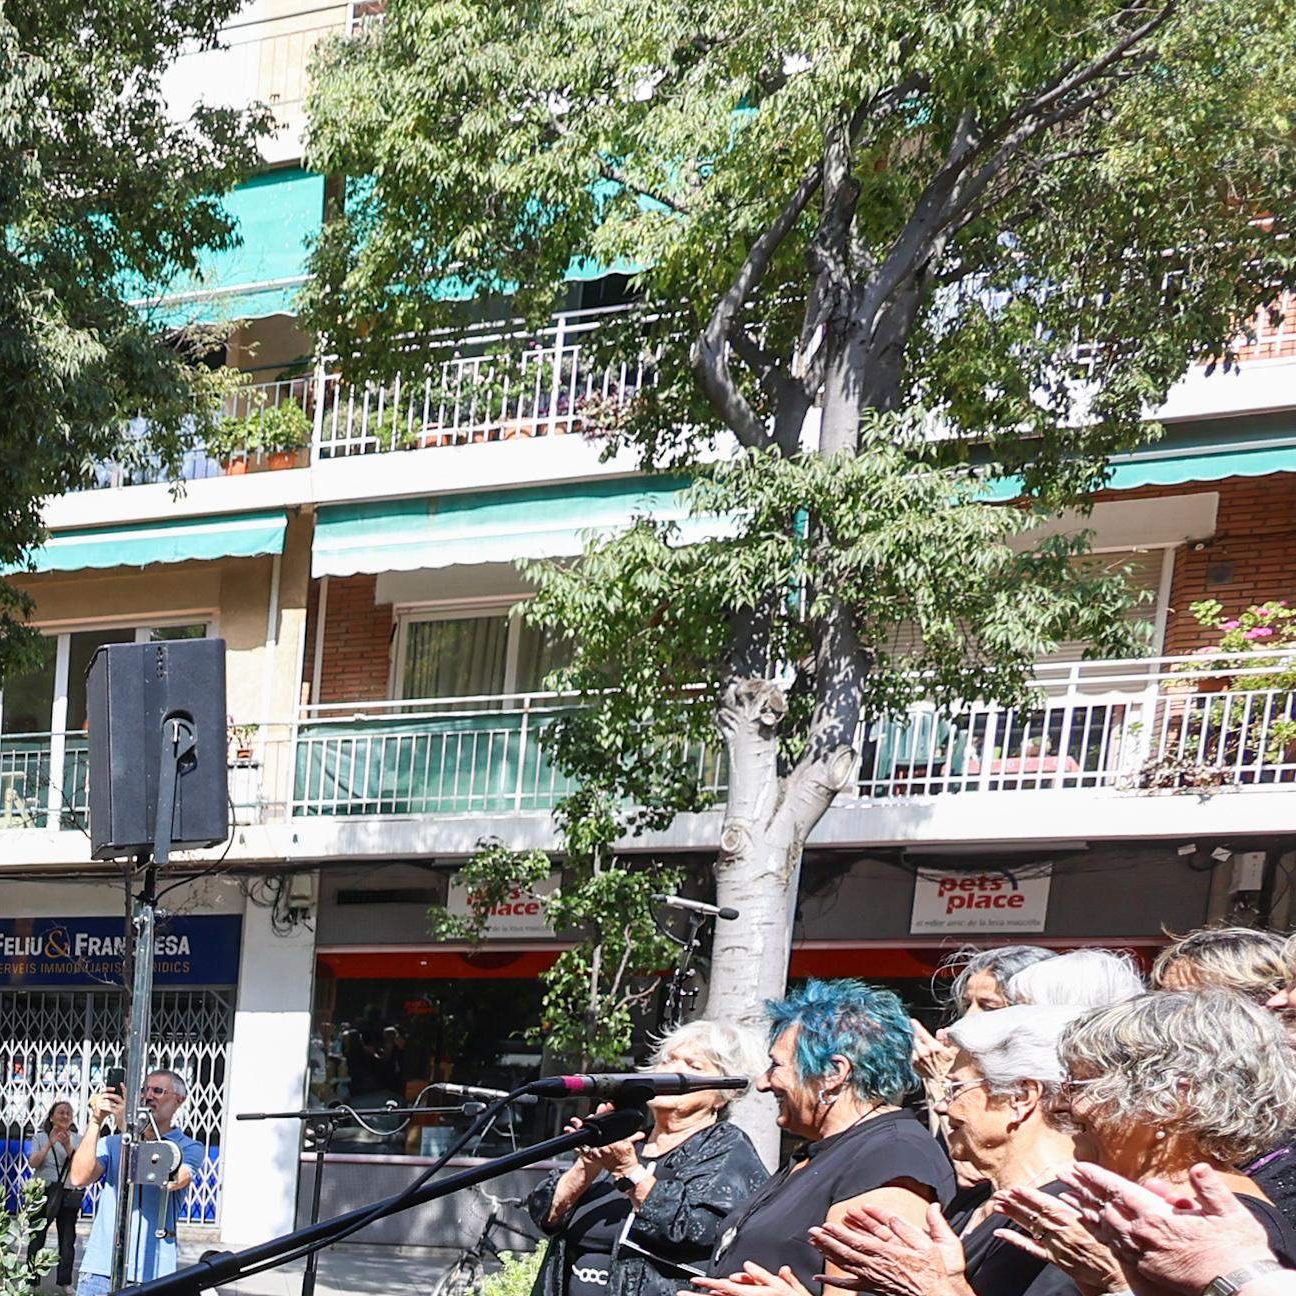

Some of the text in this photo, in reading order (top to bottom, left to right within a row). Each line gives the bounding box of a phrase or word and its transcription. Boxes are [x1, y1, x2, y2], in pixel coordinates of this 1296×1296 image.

[937, 875, 1003, 897] pets
[946, 892, 1025, 914] place
[45, 930, 68, 958] &
